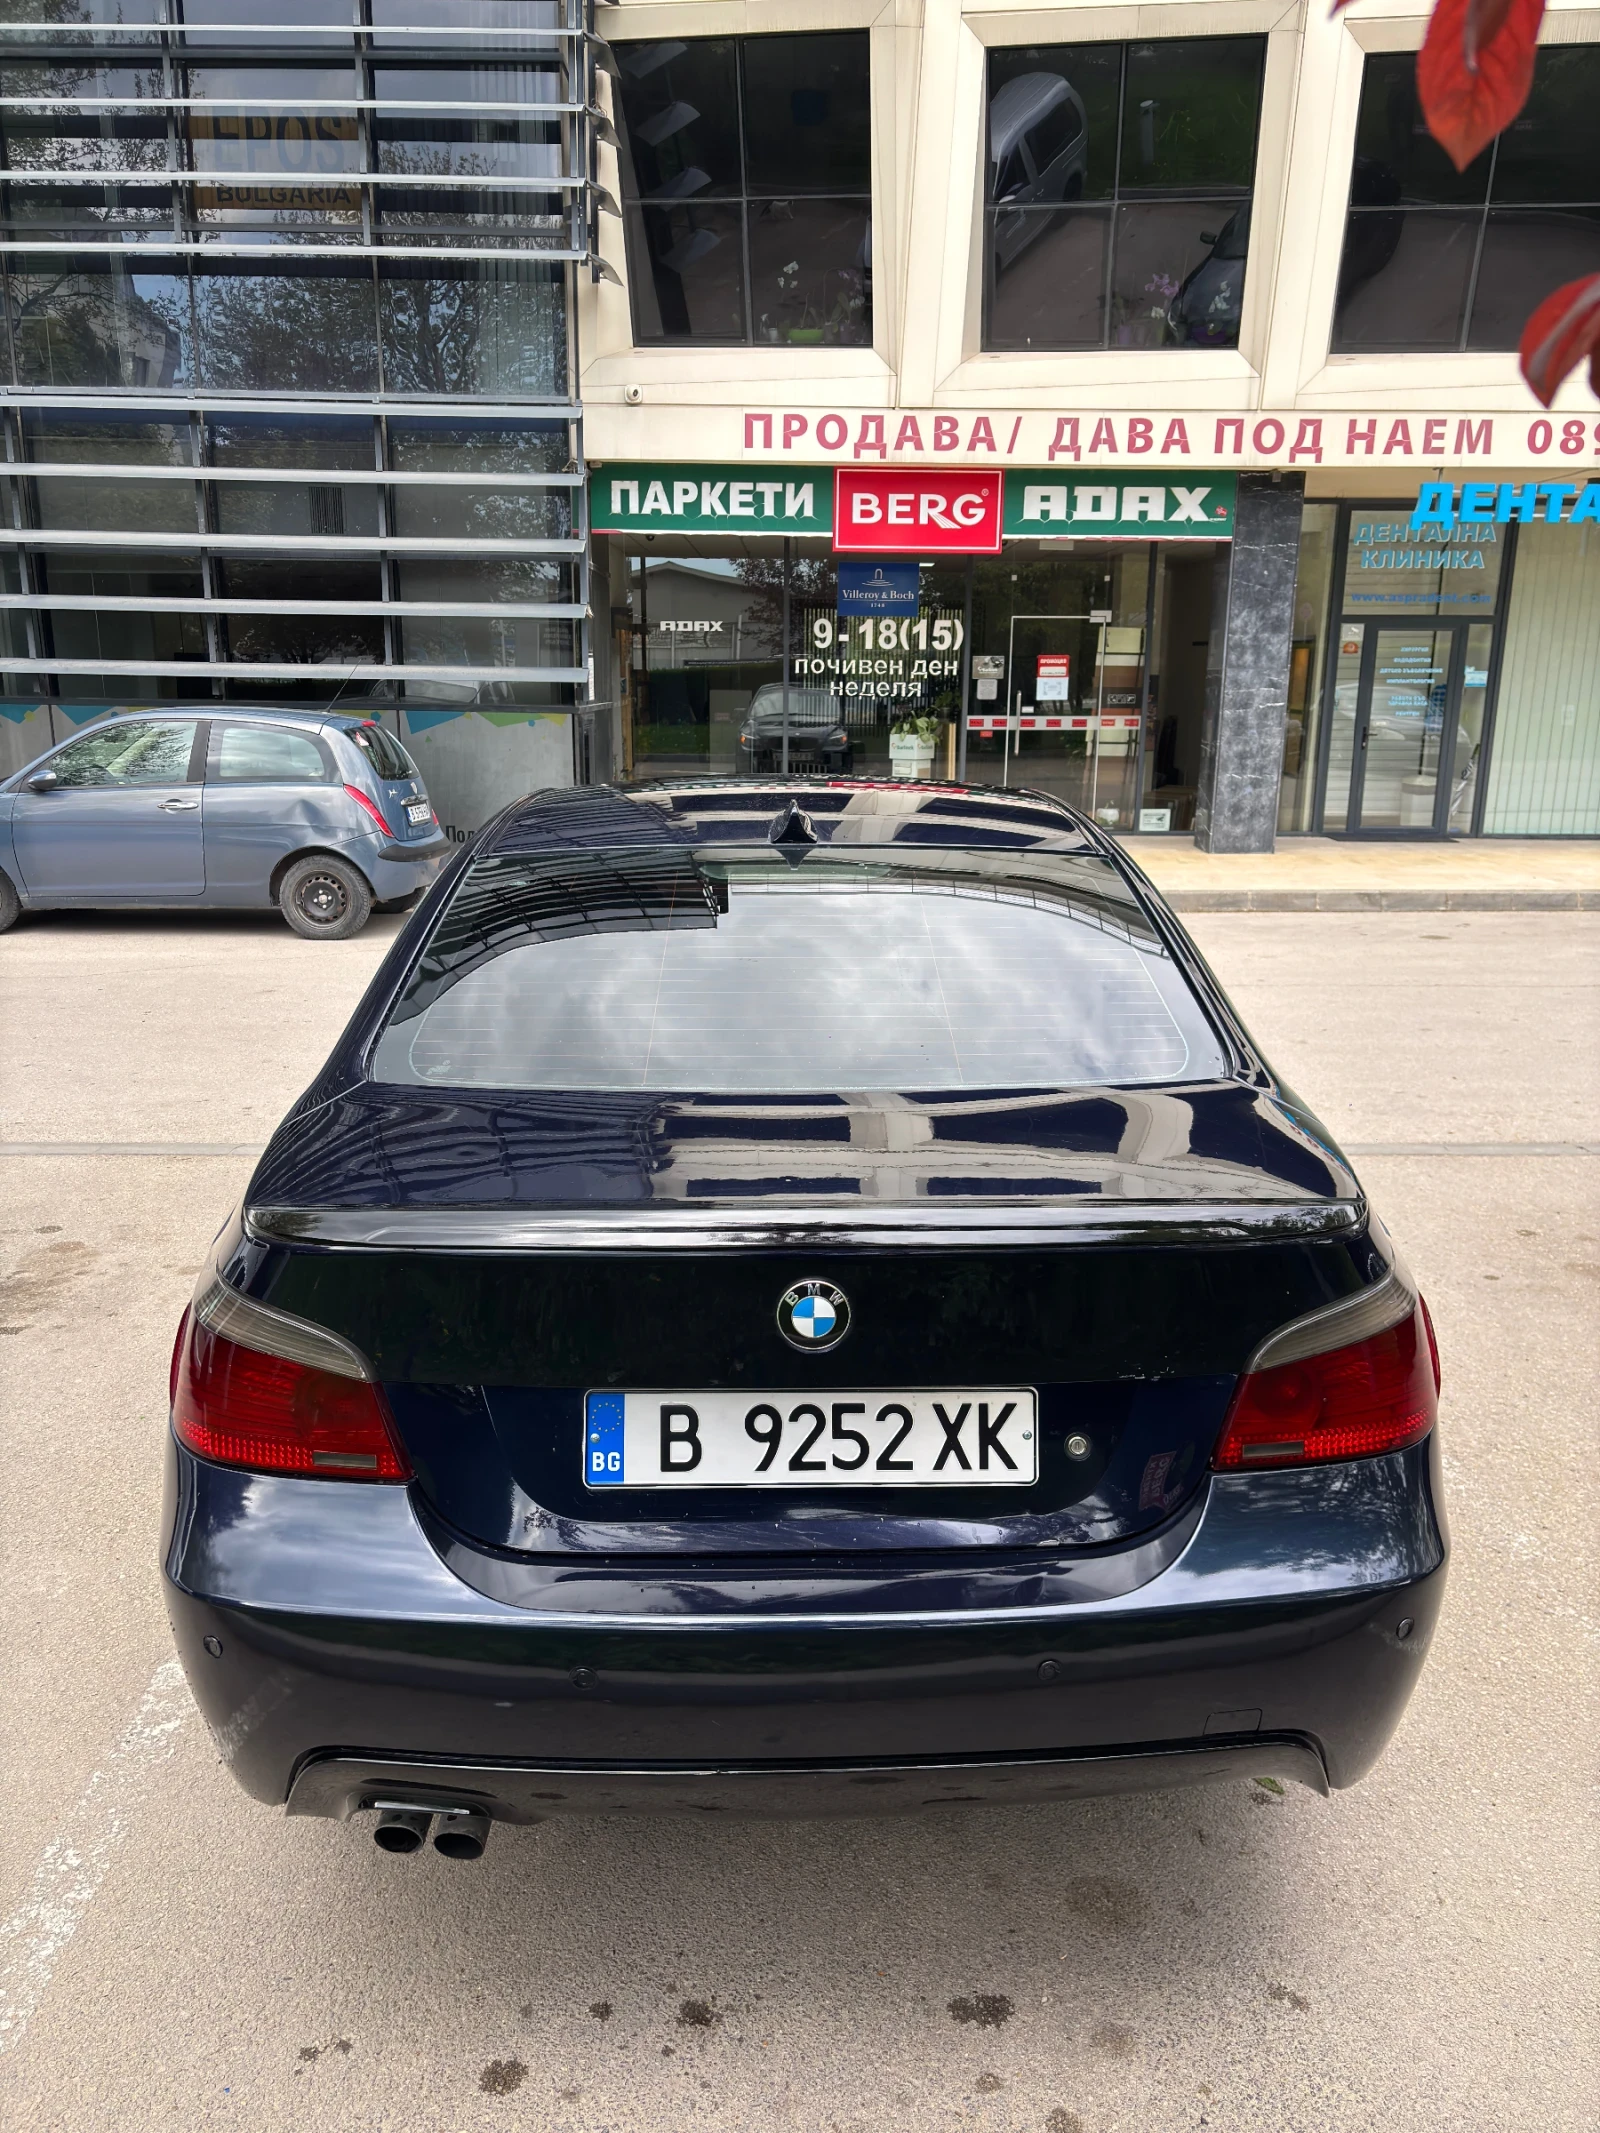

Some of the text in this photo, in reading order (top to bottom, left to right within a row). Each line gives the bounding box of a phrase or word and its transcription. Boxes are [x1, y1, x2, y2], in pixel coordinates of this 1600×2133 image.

[211, 105, 345, 173] EPOS
[216, 184, 353, 204] BULGARIA
[744, 413, 1600, 463] ПРОДАВА/ ДАВА ПОД НАЕМ 08
[610, 480, 816, 519] ПАРКЕТИ
[851, 492, 986, 530] BERG
[1022, 485, 1212, 522] ADAX
[1409, 482, 1600, 531] ДЕНТА
[1353, 523, 1497, 546] ДЕНТАЛНА
[1360, 549, 1485, 569] КЛИНИКА
[842, 589, 879, 600] Villeroy
[890, 590, 914, 600] Boch
[659, 620, 724, 632] ADAX
[813, 618, 833, 649] 9
[858, 618, 964, 651] 18(15)
[795, 658, 958, 679] почивен ден
[830, 681, 922, 699] неделя
[784, 1282, 844, 1306] BMW
[659, 1403, 703, 1473] B
[744, 1402, 914, 1473] 9252
[592, 1451, 621, 1473] BG
